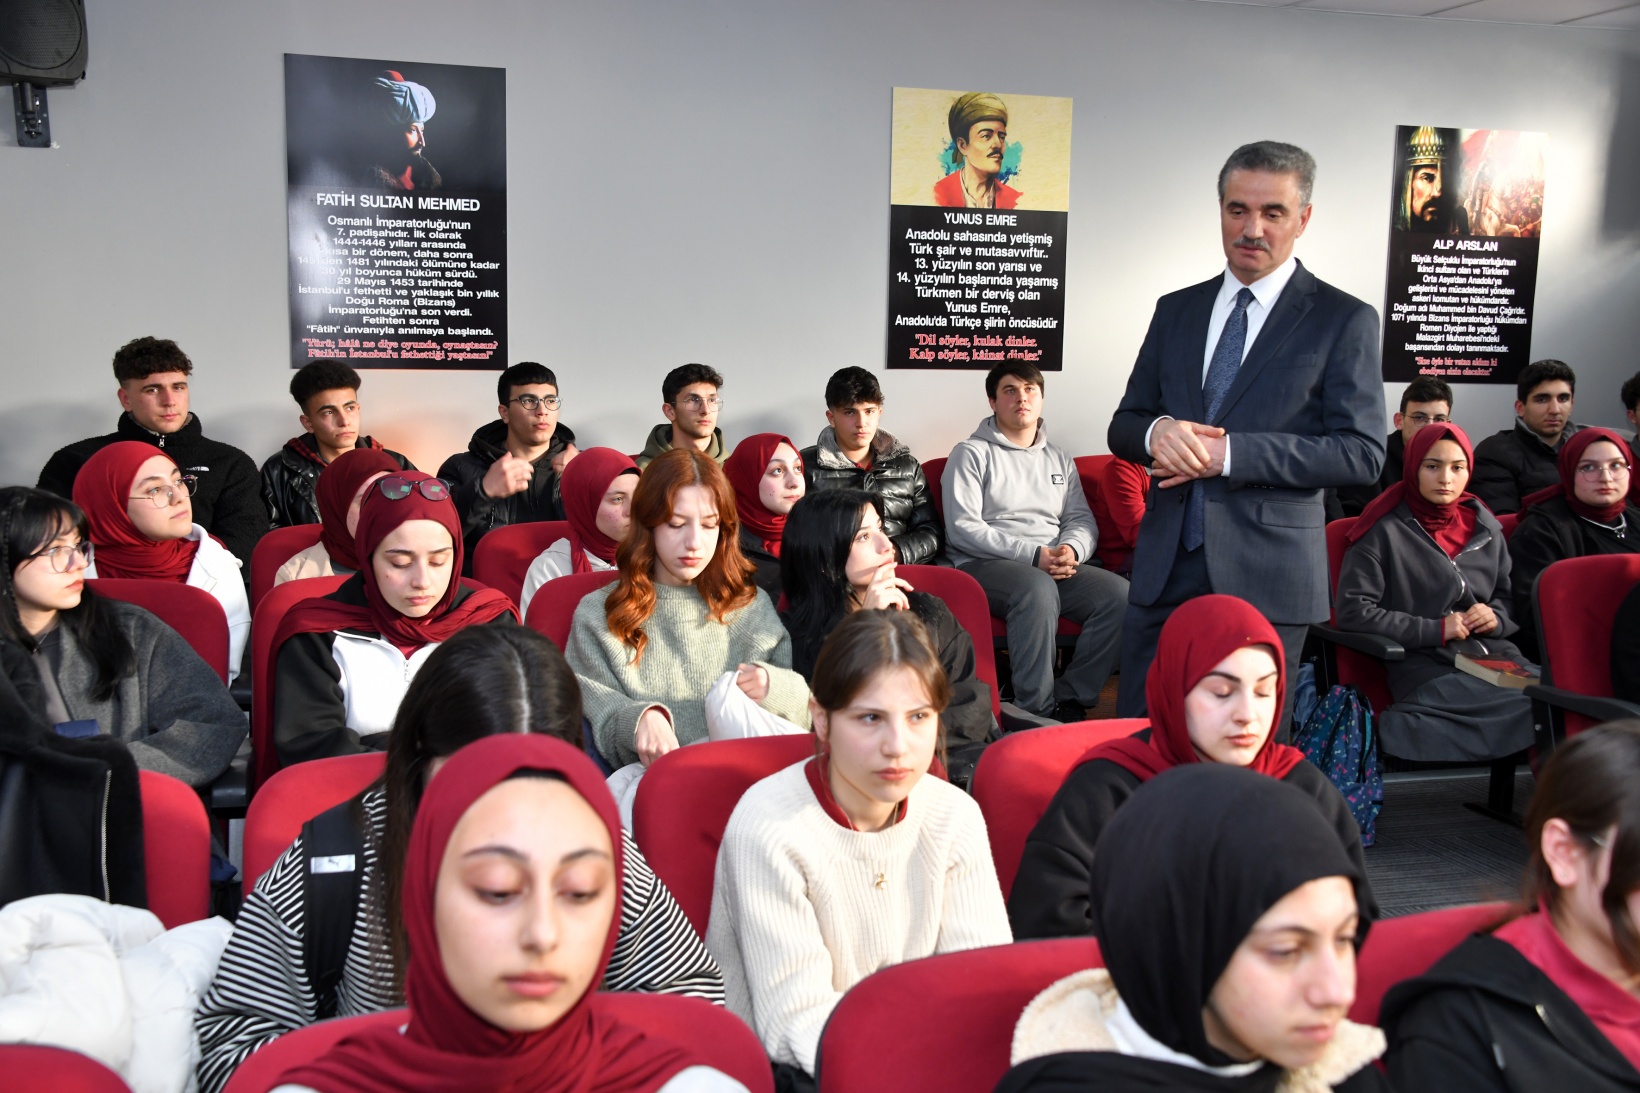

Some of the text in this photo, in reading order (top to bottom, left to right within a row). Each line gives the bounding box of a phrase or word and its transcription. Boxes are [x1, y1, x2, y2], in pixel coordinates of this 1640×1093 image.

[316, 191, 480, 211] FATİH SULTAN MEHMED
[328, 215, 471, 231] Osmanlı İmparatorluğu'nun
[944, 213, 1017, 226] YUNUS EMRE
[337, 228, 461, 240] 7. padişahıdır. İlk olarak
[905, 228, 1052, 247] Anadolu sahasında yetişmiş
[333, 238, 466, 249] 1444-1446 yılları arasında
[1433, 240, 1498, 251] ALP ARSLAN
[352, 248, 366, 256] bir
[370, 249, 410, 259] dönem,
[414, 250, 439, 258] daha
[443, 251, 473, 259] sonra
[909, 243, 933, 254] Türk
[936, 245, 956, 257] şair
[960, 247, 972, 255] ve
[347, 258, 370, 266] 1481
[374, 259, 418, 268] yılındaki
[422, 259, 467, 268] ölümüne
[471, 261, 500, 270] kadar
[915, 258, 1042, 273] 13. yüzyılın son yarısı ve
[1411, 255, 1432, 264] Büyük
[1462, 255, 1516, 267] İmparatorluğu'nun
[339, 267, 351, 277] yıl
[356, 268, 402, 278] boyunca
[406, 268, 441, 277] hüküm
[445, 269, 478, 278] sürdü.
[1482, 267, 1509, 276] Türklerin
[337, 277, 463, 287] 29 Mayıs 1453 tarihinde
[896, 272, 1058, 289] 14. yüzyılın başlarında yaşamış
[1423, 276, 1502, 286] Orta Asya'dan Anadolu'ya
[299, 284, 350, 295] İstanbul'u
[353, 287, 391, 296] fethetti
[411, 288, 453, 299] yaklaşık
[457, 289, 473, 297] bin
[476, 289, 499, 300] yıllık
[915, 287, 1040, 302] Türkmen bir derviş olan
[1449, 287, 1489, 295] mücadelesini
[1490, 288, 1514, 296] yöneten
[346, 297, 456, 308] Doğu Roma (Bizans)
[945, 302, 1011, 315] Yunus Emre,
[328, 304, 472, 317] İmparatorluğu'na son verdi.
[1394, 304, 1416, 313] Doğum
[1429, 305, 1465, 313] Muhammed
[1478, 306, 1498, 314] Davud
[895, 315, 1058, 330] Anadolu'da Türkçe şiirin öncüsüdür
[1407, 314, 1427, 322] yılında
[1429, 314, 1450, 322] Bizans
[1451, 313, 1493, 324] İmparatorluğu
[306, 325, 493, 337] "Fâtih" ünvanıyla anılmaya başlandı.
[1420, 324, 1442, 332] Romen
[1443, 324, 1466, 334] Diyojen
[378, 339, 398, 349] diye
[915, 334, 936, 345] "Dil
[939, 336, 971, 348] söyler,
[973, 336, 1003, 346] kulak
[1416, 333, 1500, 343] Malazgirt Muharebesi'ndeki
[349, 348, 398, 358] İstanbul'u
[1446, 344, 1465, 353] dolayı
[909, 349, 935, 362] Kalp
[938, 350, 970, 362] söyler,
